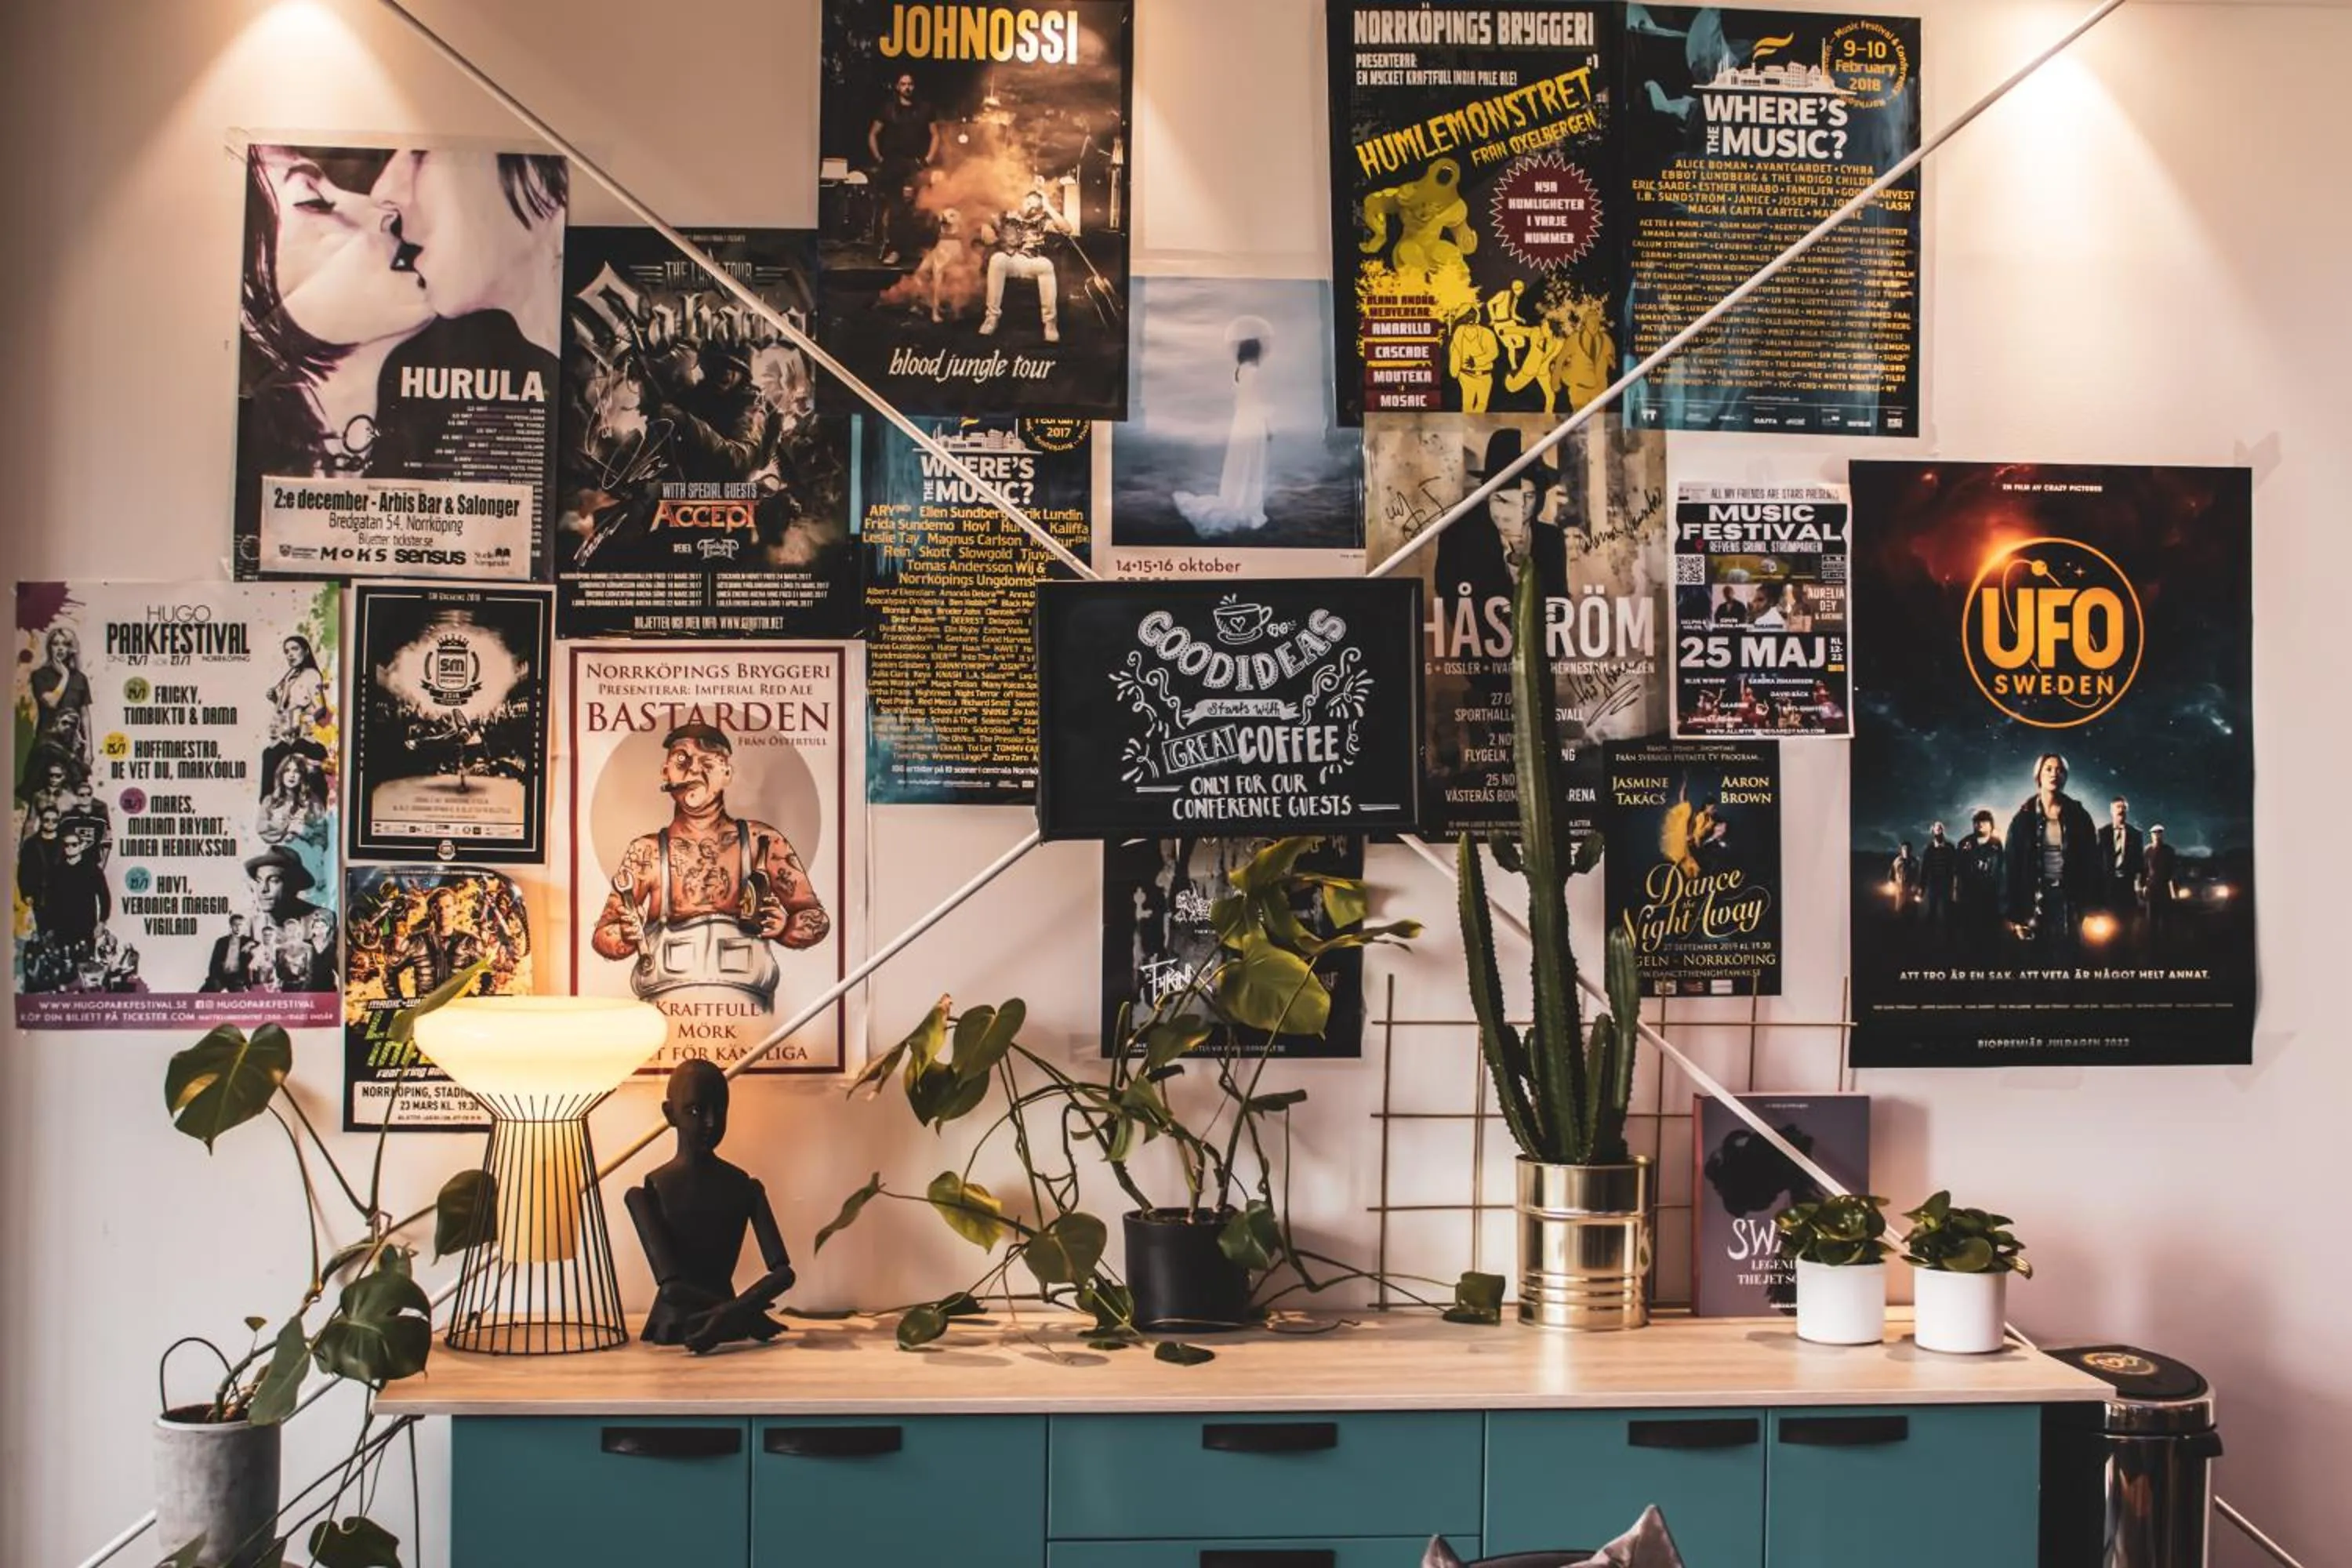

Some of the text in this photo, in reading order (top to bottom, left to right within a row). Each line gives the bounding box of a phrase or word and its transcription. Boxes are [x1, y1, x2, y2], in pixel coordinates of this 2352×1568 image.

[1354, 2, 1593, 45] NORRKÖPINGS BRYGGERI
[880, 4, 1078, 64] JOHNOSSI
[1835, 59, 1896, 78] February
[1356, 71, 1498, 85] EN MYCKET KRAFTFULL INDIA PALE
[1703, 93, 1848, 126] WHERE'S
[1355, 66, 1592, 180] HUMLEMONSTRET
[1509, 110, 1598, 154] OXELBERGEN
[1707, 125, 1848, 159] THE MUSIC?
[1675, 159, 1704, 169] ALICE
[1700, 171, 1759, 182] LUNDBERG
[1772, 174, 1791, 183] THE
[1795, 175, 1832, 184] INDIGO
[1534, 181, 1557, 192] NYA
[1632, 180, 1655, 189] ERIC
[1658, 181, 1691, 190] SAADE
[1786, 186, 1834, 195] FAMILJEN
[1508, 198, 1584, 210] HUMLIGHETER
[1688, 205, 1807, 217] MAGNA CARTA CARTEL
[1734, 194, 1911, 211] JANICE JOSEPH LASH
[1534, 216, 1568, 227] VARJE
[1525, 233, 1574, 244] NUMMER
[1373, 323, 1431, 335] AMARILLO
[1375, 346, 1429, 358] CASCADE
[888, 348, 1056, 383] blood jungle tour
[401, 366, 545, 402] HURULA
[1381, 395, 1427, 407] MOSAIC
[1047, 428, 1071, 437] 2017
[662, 483, 757, 499] WITH SPECIAL GUESTS
[924, 480, 934, 502] THE
[274, 488, 520, 518] 2:e december Arbis Bar & Salonger
[1044, 508, 1083, 520] Lundin
[1709, 504, 1815, 522] MUSIC
[328, 513, 383, 532] Bredgatan
[865, 519, 954, 531] Frida Sundemo
[927, 533, 1022, 546] Magnus Carlson
[1682, 523, 1842, 540] FESTIVAL
[395, 550, 466, 565] sensus
[906, 559, 1013, 573] Tomas Andersson
[1178, 559, 1242, 573] oktober
[147, 604, 211, 622] HUGO
[1424, 582, 1654, 658] HÅSRÖM
[1981, 587, 2125, 670] UFO
[106, 623, 251, 654] PARKFESTIVAL
[1680, 637, 1825, 667] 25 MAJ
[586, 662, 830, 680] NORRKÖPINGS BRYGGERI
[1444, 662, 1480, 673] OSSLER
[695, 684, 755, 695] IMPERIAL
[760, 684, 786, 695] RED
[789, 684, 813, 695] ALE
[1994, 675, 2114, 695] SWEDEN
[154, 686, 201, 704] FRICKY,
[124, 707, 185, 724] TIMBUKTU
[189, 707, 198, 724] &
[586, 702, 830, 732] BASTARDEN
[135, 740, 221, 759] HOFFMAESTRO,
[1168, 725, 1339, 768] GREAT COFFEE
[111, 761, 125, 779] DE
[129, 762, 151, 779] VET
[178, 761, 246, 779] MARKOOLIO
[1190, 774, 1307, 796] ONLY FOR OUR
[1612, 776, 1669, 789] JASMINE
[1722, 776, 1770, 788] AARON
[1720, 792, 1772, 804] BROWN
[1173, 796, 1352, 820] CONFERENCE GUESTS
[128, 817, 228, 836] MIRIAM BRYANT,
[163, 839, 236, 857] HENRIKSSON
[1646, 862, 1744, 906] Dance
[122, 897, 232, 916] VERONICA MAGGIO,
[144, 918, 198, 935] VIGILAND
[1623, 902, 1693, 953] Night
[1684, 953, 1776, 966] NORRKÖPING
[1900, 971, 1920, 980] ATT
[1923, 971, 1946, 980] TRO
[2019, 971, 2039, 980] ATT
[2042, 971, 2070, 980] VETA
[2139, 971, 2165, 979] HELT
[656, 1000, 760, 1018] KRAFTFULL
[677, 1022, 737, 1038] MÖRK
[412, 1101, 437, 1110] MARS
